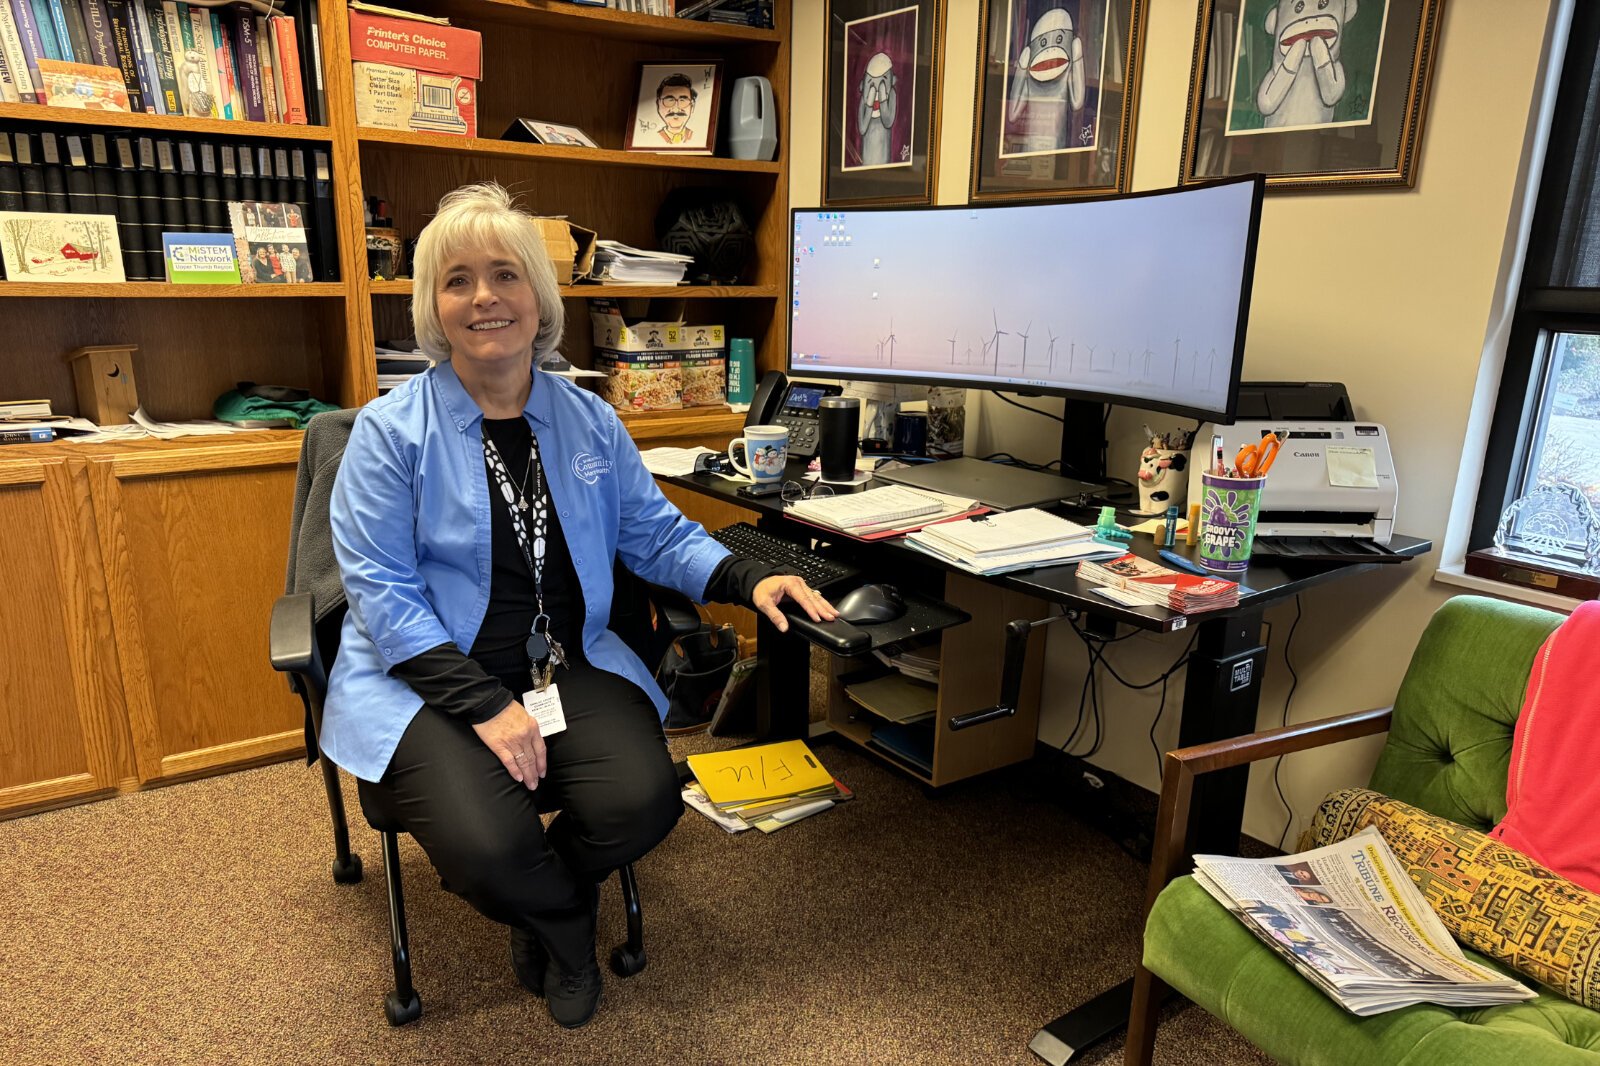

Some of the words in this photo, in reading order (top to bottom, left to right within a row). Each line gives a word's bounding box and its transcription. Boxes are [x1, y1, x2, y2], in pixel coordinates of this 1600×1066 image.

[20, 0, 29, 27] Learning
[193, 18, 202, 31] The
[242, 17, 252, 44] DSM-5
[367, 26, 410, 42] Printer's
[412, 34, 447, 49] Choice
[112, 18, 126, 54] BEHAVIORAL
[120, 55, 131, 84] RESEARCH
[120, 27, 134, 67] FOUNDATIONS
[129, 69, 136, 78] OF
[153, 8, 171, 53] Psychological
[164, 54, 176, 80] Testing
[195, 34, 206, 57] Social
[366, 38, 416, 55] COMPUTER
[418, 47, 447, 60] PAPER
[0, 48, 12, 84] TERVIEW
[168, 94, 176, 110] USED
[189, 255, 231, 263] Network
[669, 331, 676, 339] 52
[713, 329, 721, 337] 52
[577, 458, 613, 471] Community
[1205, 533, 1236, 547] GRAPE
[1206, 524, 1237, 536] GROOVY
[1351, 850, 1384, 902] TRIBUNE
[1367, 847, 1385, 875] Deckerville
[1382, 875, 1390, 886] H.S.
[1388, 886, 1403, 907] Football
[1381, 905, 1434, 956] RECORDER
